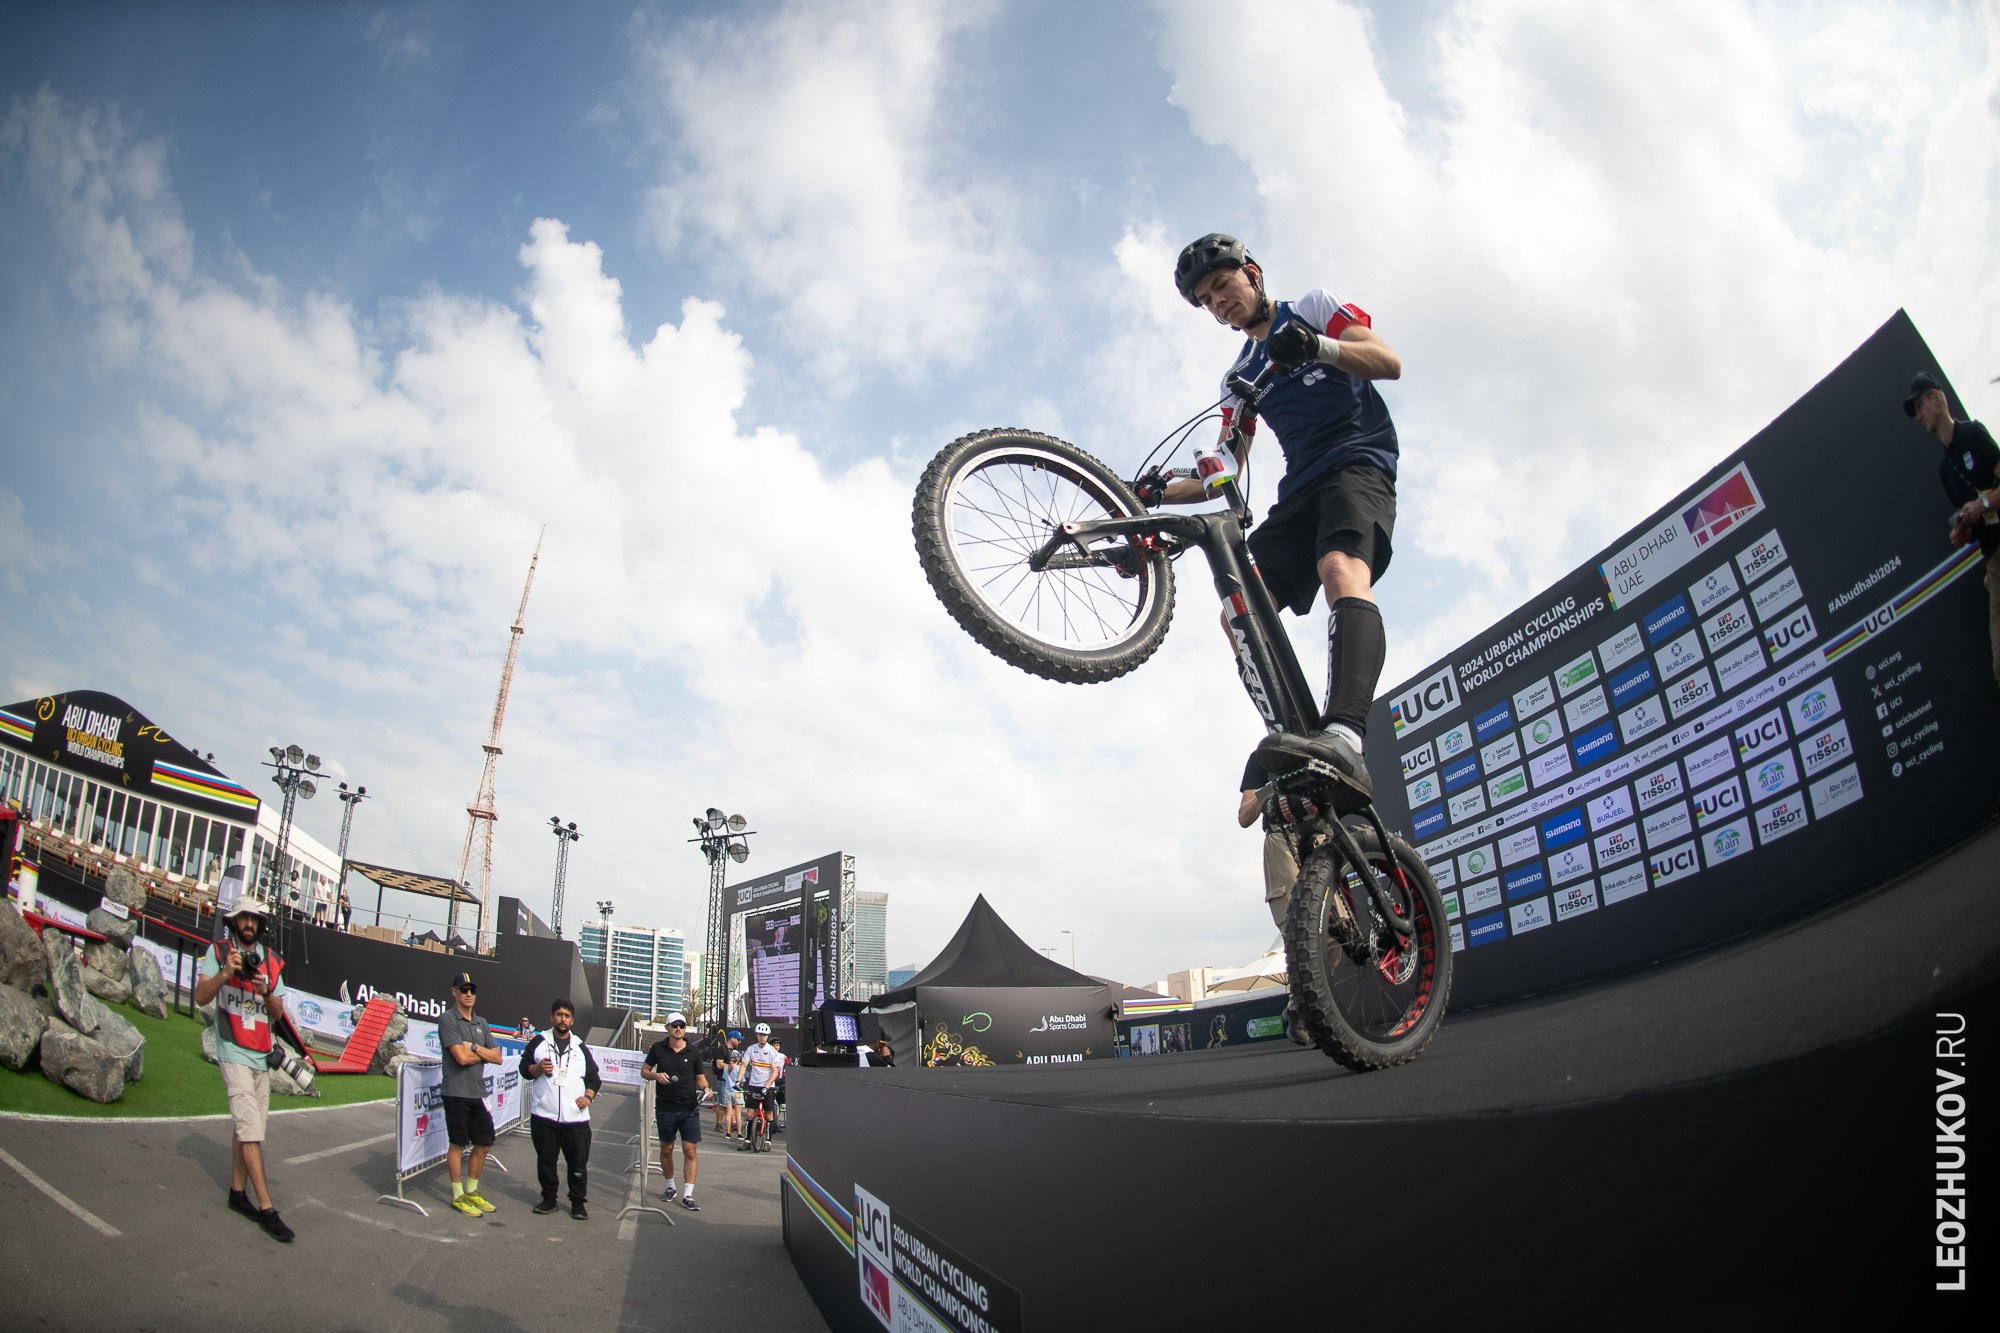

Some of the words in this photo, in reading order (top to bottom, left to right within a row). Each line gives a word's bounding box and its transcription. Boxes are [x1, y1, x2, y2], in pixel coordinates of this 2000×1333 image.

[1613, 555, 1637, 579] ABU
[1639, 525, 1678, 561] DHABI
[1744, 545, 1780, 574] TISSOT
[1618, 571, 1644, 595] UAE
[1756, 597, 1768, 607] bike
[1768, 589, 1778, 599] abu
[1779, 578, 1795, 592] dhabi
[1828, 556, 1901, 614] #Abudhabi2024
[1701, 586, 1730, 607] BURJEEL
[1648, 606, 1685, 633] SHIMANO
[1709, 615, 1745, 642] TISSOT
[1865, 605, 1895, 634] UCI
[1459, 659, 1484, 677] 2024
[1485, 630, 1523, 661] URBAN
[1525, 596, 1575, 636] CYCLING
[1614, 641, 1624, 650] Abu
[1624, 633, 1638, 645] Dhabi
[1775, 615, 1811, 648] UCI
[1462, 662, 1503, 692] WORLD
[1506, 598, 1604, 666] CHAMPIONSHIPS
[1616, 646, 1628, 656] Sports
[1627, 639, 1639, 649] Council
[1666, 653, 1695, 672] BURJEEL
[1720, 666, 1731, 676] bike
[1732, 659, 1742, 668] abu
[1743, 648, 1759, 661] dhabi
[1878, 652, 1902, 670] uci.org
[1613, 670, 1650, 696] SHIMANO
[1884, 662, 1922, 690] uci_cycling
[1402, 676, 1454, 724] UCI
[1529, 686, 1548, 700] tadweer
[1531, 694, 1545, 706] group
[1580, 703, 1589, 711] Abu
[1589, 695, 1603, 706] Dhabi
[1672, 683, 1709, 708] TISSOT
[1705, 708, 1732, 726] ucichannel
[1746, 685, 1774, 704] uci_cycling
[1787, 661, 1816, 681] uci_cycling
[1890, 696, 1903, 710] UCI
[1581, 707, 1593, 716] Sports
[1592, 700, 1605, 711] Council
[1803, 710, 1812, 719] al
[1812, 701, 1827, 714] ain
[1896, 701, 1932, 729] ucichannel
[61, 704, 87, 731] ABU
[85, 710, 122, 741] DHABI
[1477, 711, 1508, 732] SHIMANO
[1629, 717, 1658, 736] BURJEEL
[77, 731, 97, 749] URBAN
[98, 738, 123, 756] CYCLING
[1745, 718, 1782, 749] UCI
[1901, 720, 1939, 749] uci_cycling
[67, 741, 84, 756] WORLD
[84, 746, 125, 768] CHAMPIONSHIPS
[1495, 742, 1515, 755] tadweer
[1497, 750, 1511, 760] group
[1577, 733, 1613, 756] SHIMANO
[1806, 738, 1846, 765] TISSOT
[1905, 741, 1944, 769] uci_cycling
[1407, 748, 1432, 770] UCI
[1545, 764, 1556, 772] Sports
[1556, 759, 1568, 768] Council
[1554, 753, 1567, 763] Dhabi
[1689, 762, 1700, 772] bike
[1701, 757, 1712, 766] abu
[1713, 748, 1728, 760] dhabi
[1446, 764, 1476, 782] SHIMANO
[1761, 778, 1769, 788] al
[1769, 771, 1785, 784] ain
[1829, 783, 1840, 793] Abu
[1840, 774, 1857, 786] Dhabi
[1462, 794, 1481, 805] tadweer
[1641, 778, 1677, 800] TISSOT
[1830, 789, 1844, 800] Sports
[1843, 781, 1858, 793] Council
[1464, 801, 1477, 811] group
[1703, 786, 1739, 815] UCI
[1414, 813, 1443, 830] SHIMANO
[1596, 808, 1625, 823] BURJEEL
[1647, 825, 1658, 833] bike
[1659, 820, 1670, 829] abu
[1671, 813, 1686, 824] dhabi
[1762, 808, 1802, 834] TISSOT
[1523, 835, 1535, 844] Dhabi
[1546, 819, 1581, 839] SHIMANO
[1524, 841, 1536, 849] Council
[1600, 838, 1635, 858] TISSOT
[1557, 864, 1584, 878] BURJEEL
[1659, 850, 1694, 876] UCI
[1507, 872, 1542, 890] SHIMANO
[1605, 883, 1615, 891] bike
[1616, 879, 1626, 887] abu
[1627, 873, 1643, 882] dhabi
[740, 890, 751, 901] UCI
[1559, 895, 1593, 912] TISSOT
[1471, 922, 1502, 936] SHIMANO
[1517, 916, 1544, 928] BURJEEL
[1049, 1023, 1067, 1031] Sports
[1065, 1014, 1086, 1022] Dhabi
[860, 1197, 889, 1259] UCI
[893, 1224, 910, 1250] 2024
[910, 1234, 940, 1276] URBAN
[940, 1258, 989, 1311] CYCLING
[894, 1248, 922, 1286] WORLD
[898, 1293, 911, 1320] ABU
